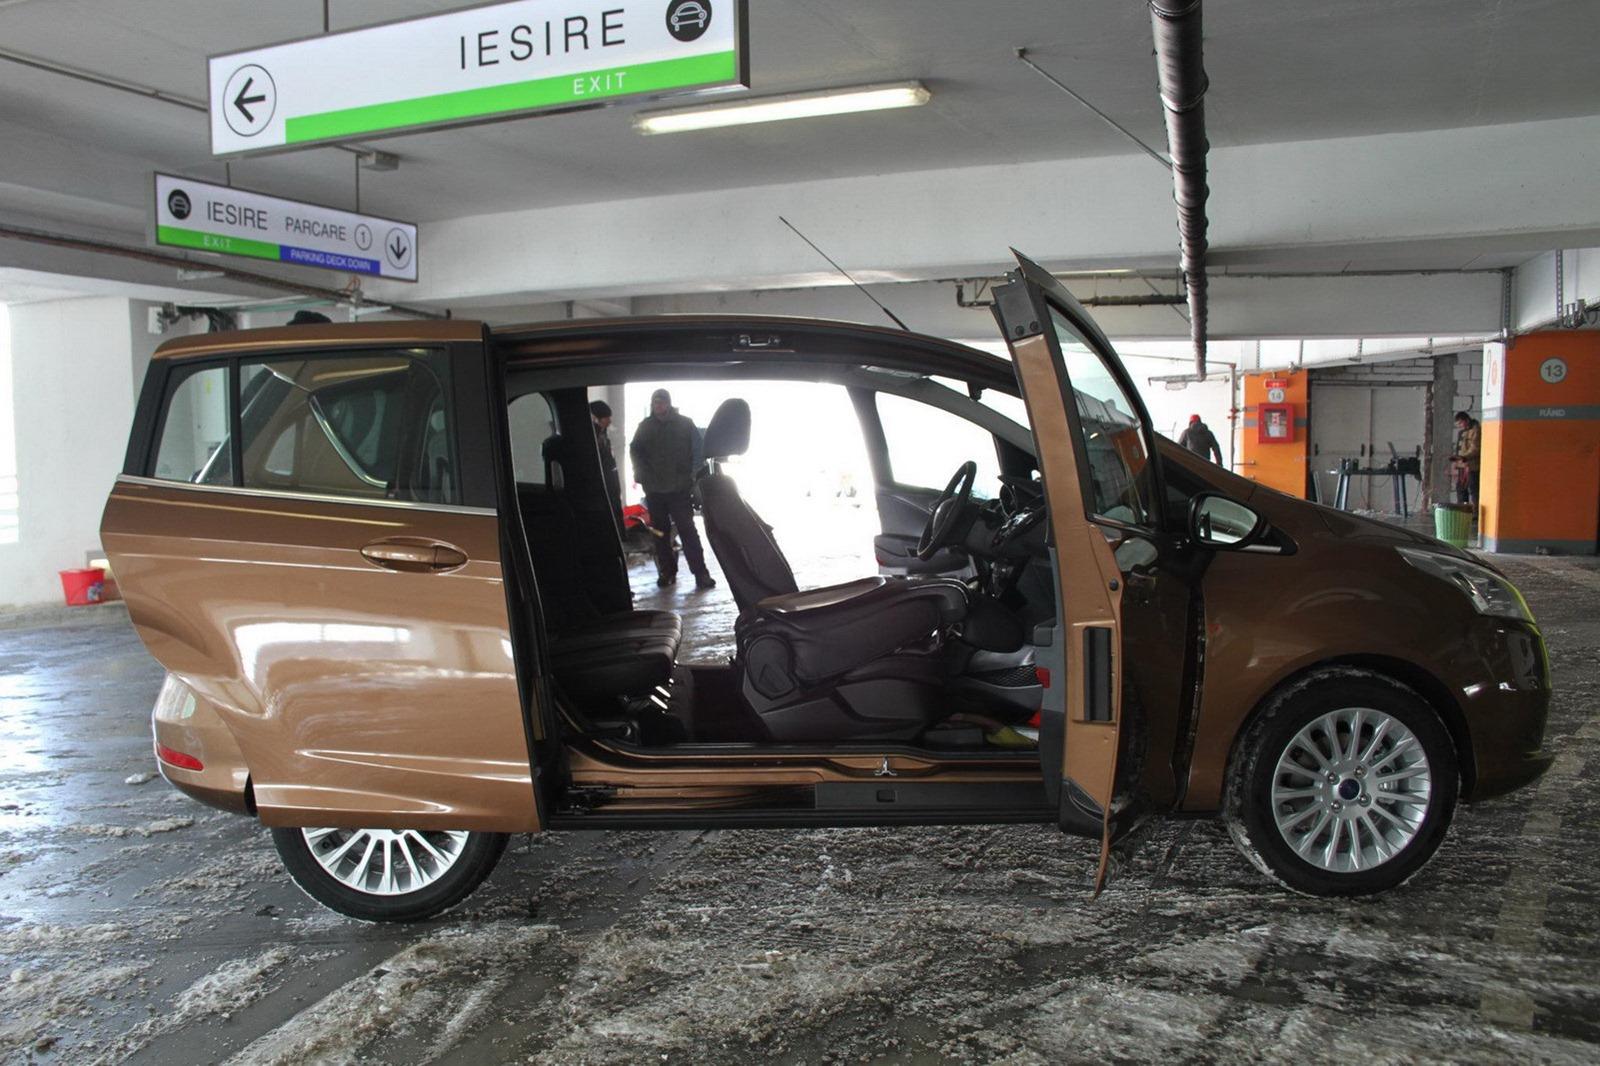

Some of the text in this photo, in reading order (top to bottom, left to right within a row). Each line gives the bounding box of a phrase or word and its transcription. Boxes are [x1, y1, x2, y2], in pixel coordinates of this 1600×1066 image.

[460, 8, 625, 70] IESIRE
[573, 72, 626, 95] EXIT
[206, 201, 268, 231] IESIRE
[285, 216, 347, 241] PARCARE
[203, 235, 232, 248] EXIT
[290, 249, 371, 271] PARKING DECK DOWN
[1544, 364, 1563, 377] 13
